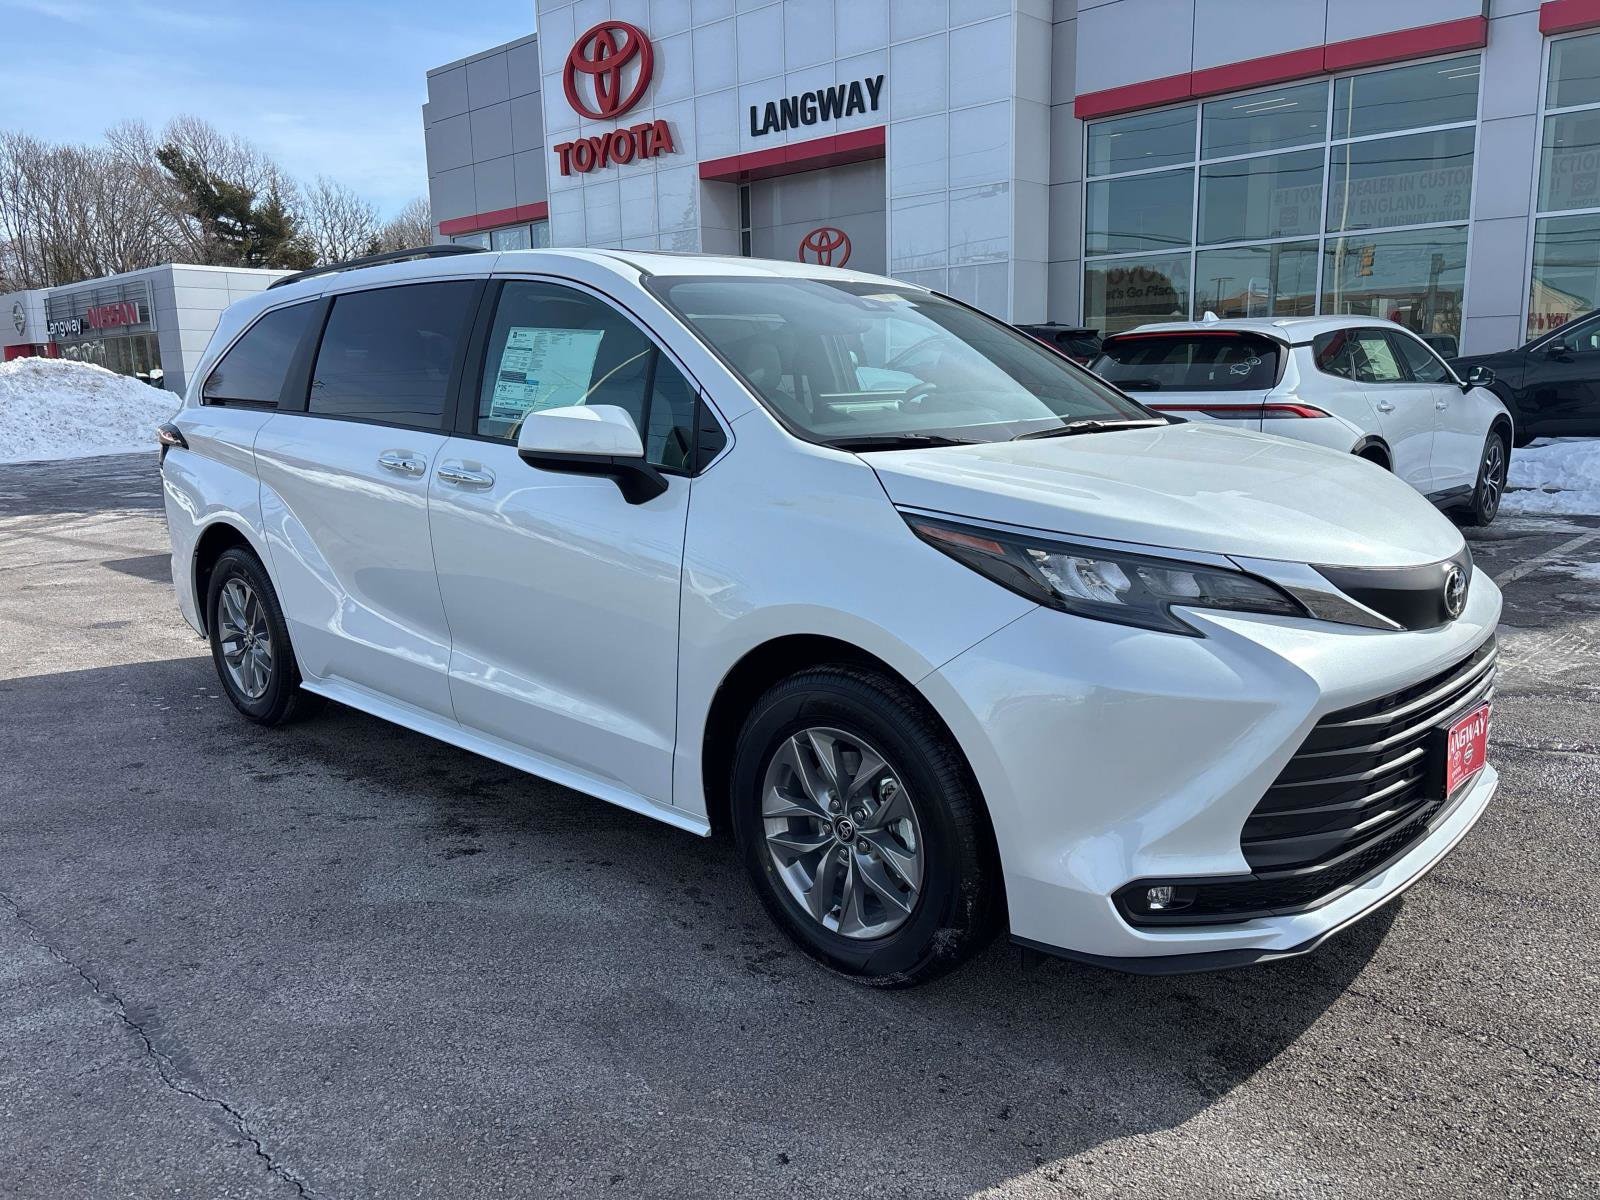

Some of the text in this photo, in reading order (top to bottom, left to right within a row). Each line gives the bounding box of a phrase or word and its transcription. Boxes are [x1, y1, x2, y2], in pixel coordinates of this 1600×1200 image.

[750, 74, 885, 137] LANGWAY
[554, 119, 676, 176] TOYOTA
[1349, 177, 1394, 197] DEALER
[1400, 175, 1414, 192] IN
[1308, 205, 1321, 221] IN
[1126, 286, 1143, 298] Go
[46, 302, 141, 337] Langway NISSAN
